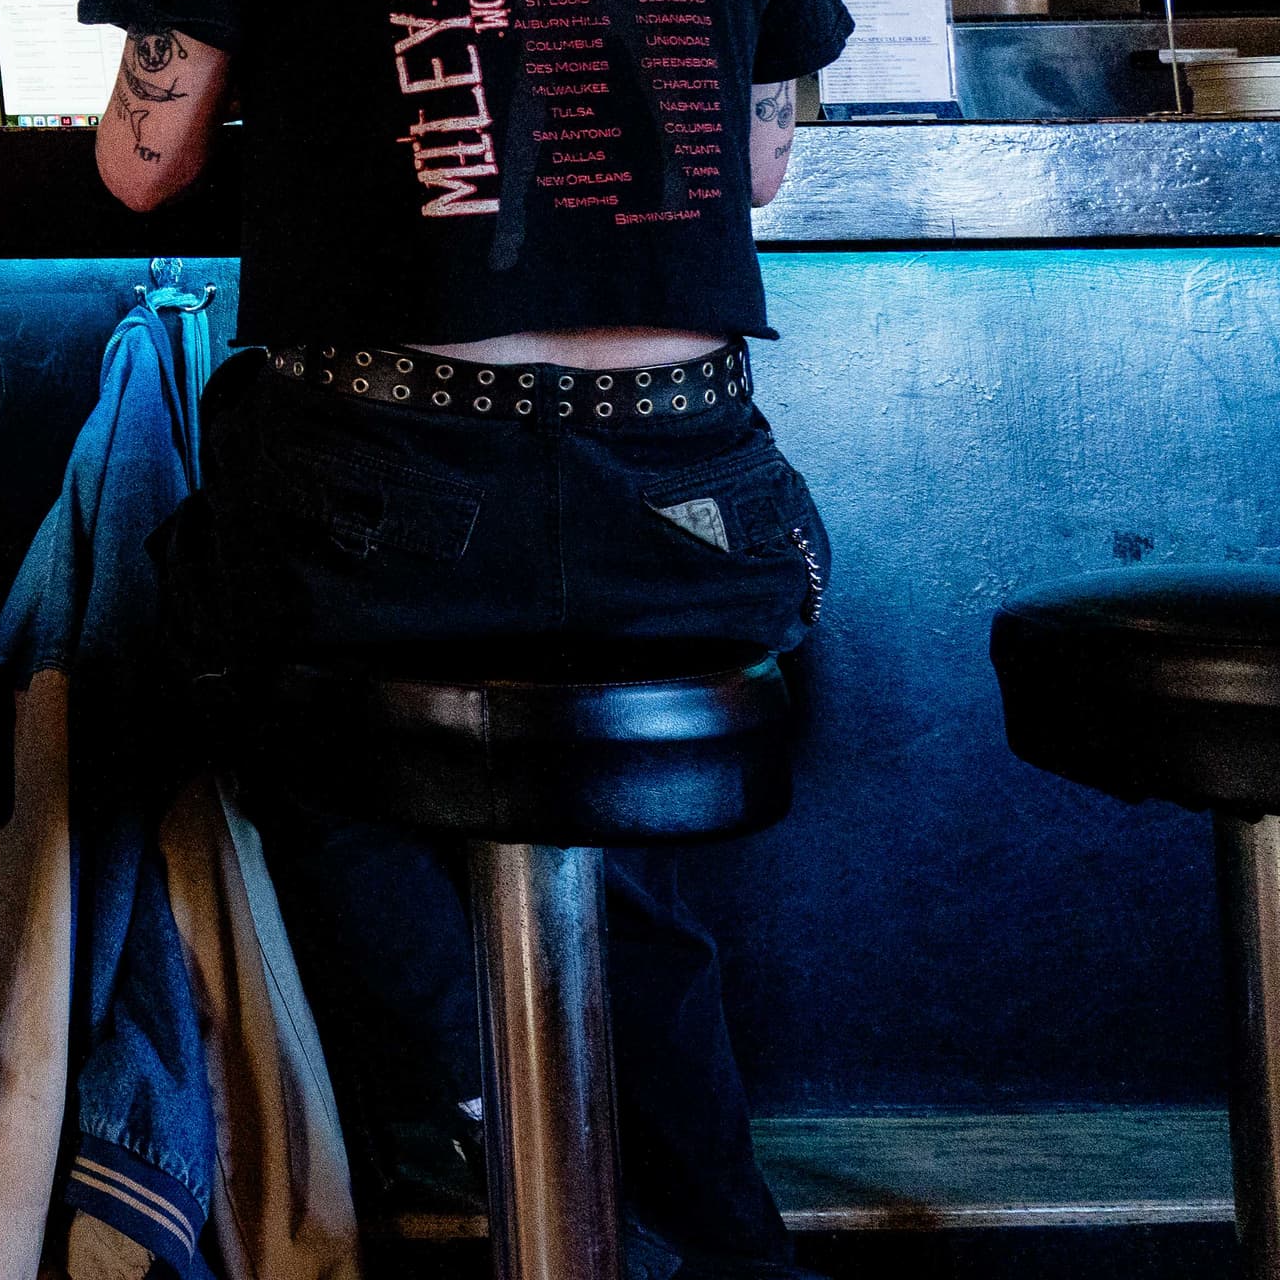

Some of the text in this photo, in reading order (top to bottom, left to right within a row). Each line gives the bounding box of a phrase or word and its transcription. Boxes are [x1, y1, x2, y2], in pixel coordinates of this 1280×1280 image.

[513, 15, 611, 29] AUBURN HILLS
[635, 13, 712, 26] INDIANAPOLIS
[525, 38, 604, 51] COLUMBUS
[646, 36, 710, 47] UNIONDALE
[526, 60, 609, 75] DES MOINES
[532, 83, 609, 96] MILWAUKEE
[652, 79, 720, 91] CHARLOTTE
[551, 106, 594, 118] TULSA
[660, 100, 721, 112] NASHVILLE
[389, 12, 501, 217] MILEY
[532, 127, 622, 141] SAN ANTONIO
[665, 122, 723, 134] COLUMBIA
[674, 144, 721, 155] ATLANTA
[552, 151, 606, 163] DALLAS
[683, 167, 720, 177] TAMPA
[536, 172, 633, 187] NEW ORLEANS
[554, 195, 618, 208] MEMPHIS
[615, 210, 701, 225] BIRMINGHAM
